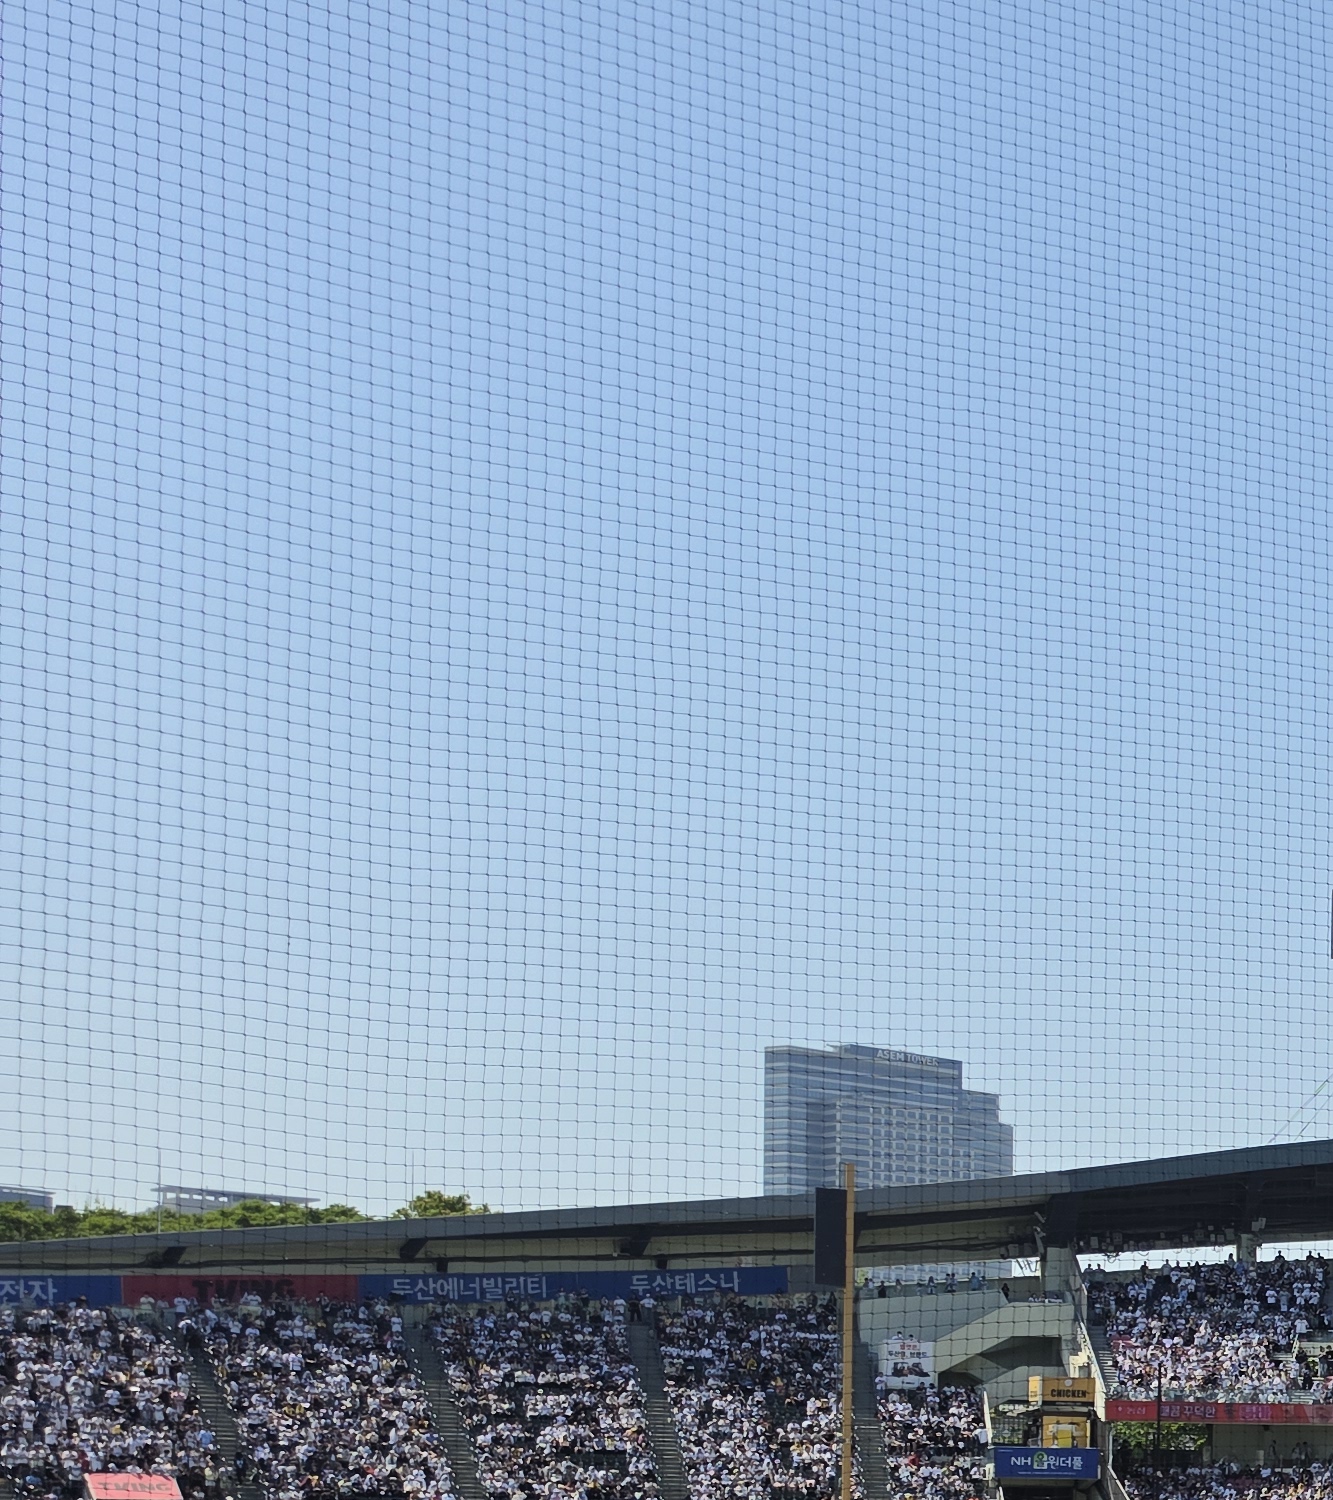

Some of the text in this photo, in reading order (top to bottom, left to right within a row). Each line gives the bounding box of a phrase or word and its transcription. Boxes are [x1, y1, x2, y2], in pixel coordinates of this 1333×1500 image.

[391, 1275, 548, 1300] 두산에너빌리티
[629, 1270, 742, 1294] 두산테스나
[1050, 1388, 1088, 1398] CHICKEN
[1010, 1455, 1031, 1467] NH
